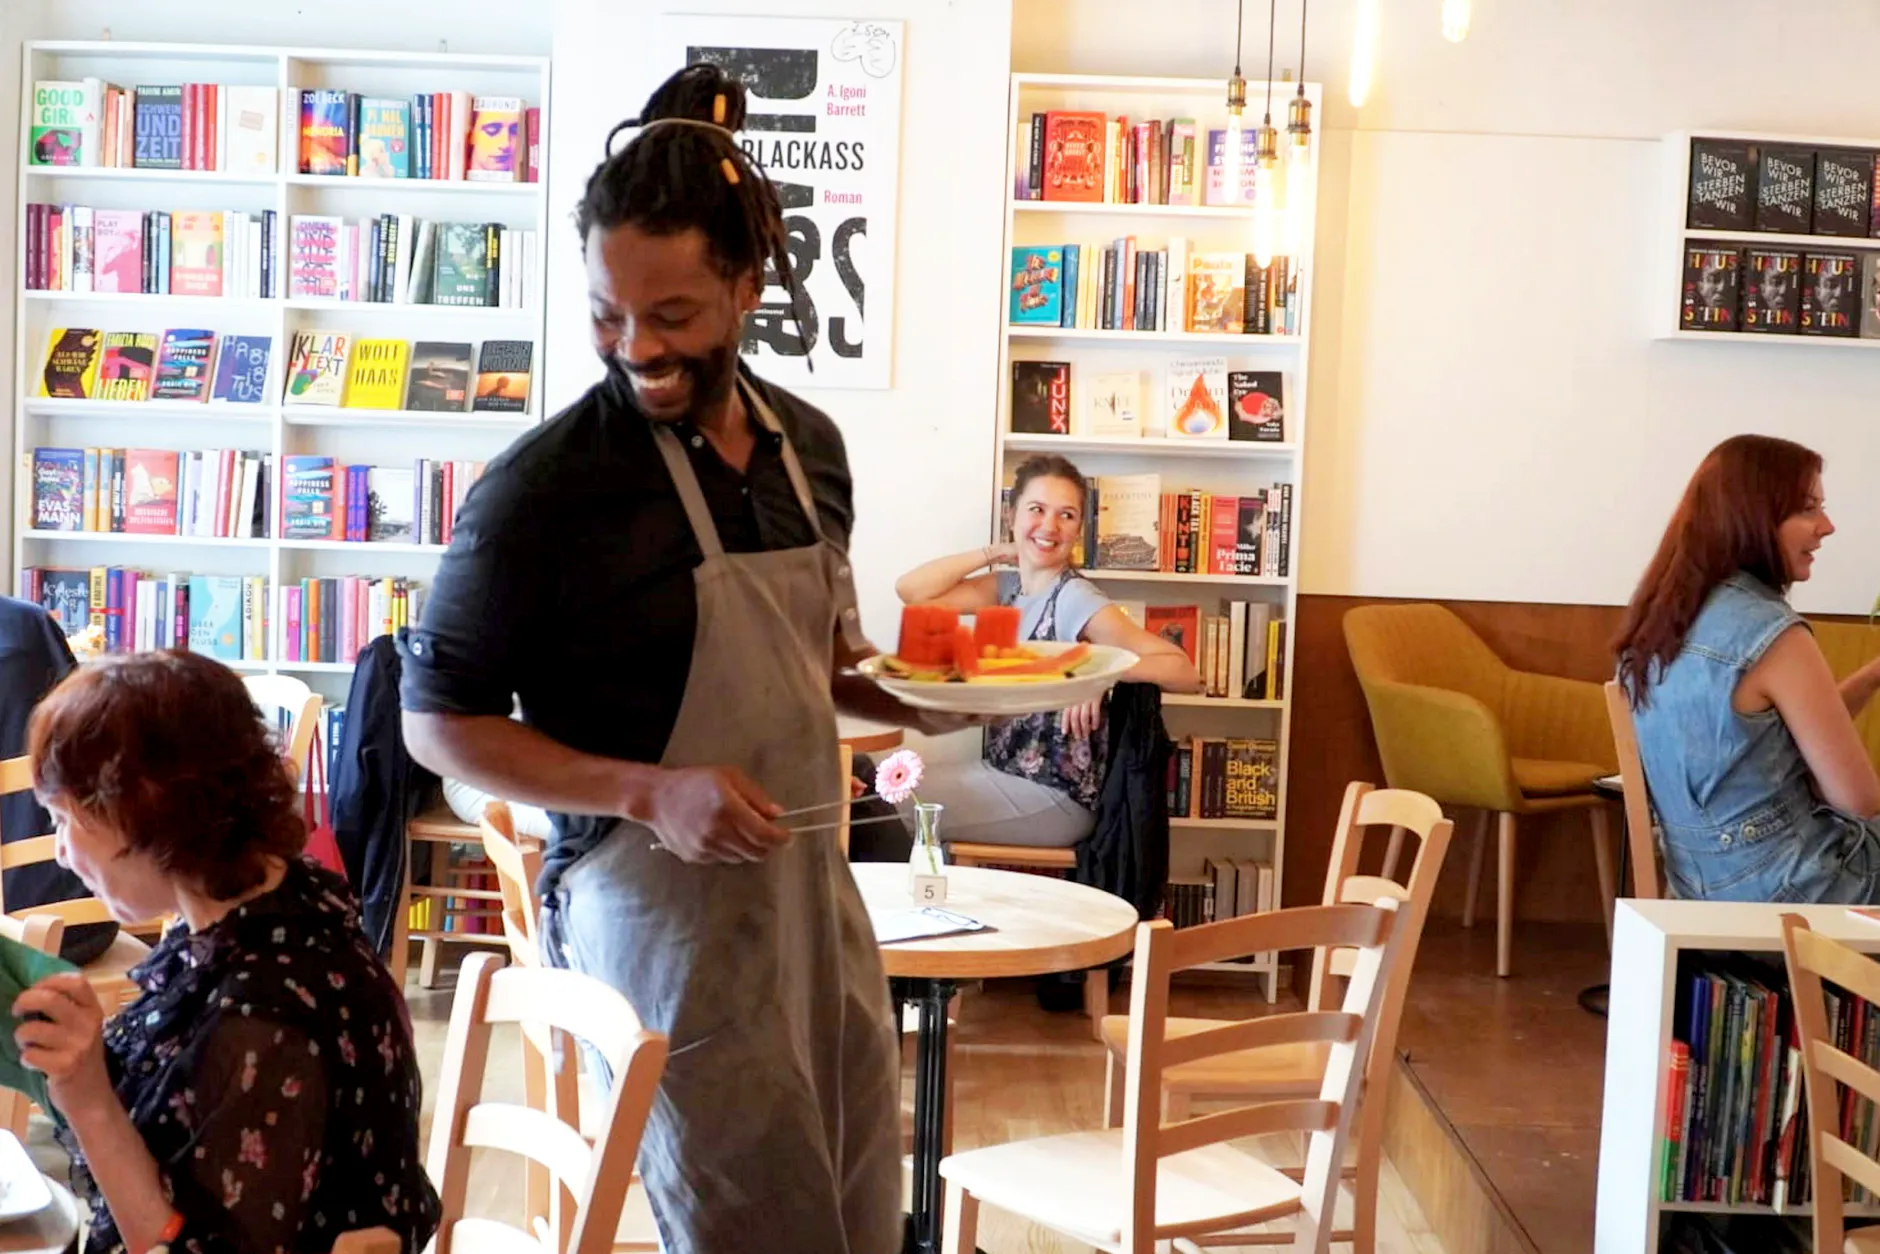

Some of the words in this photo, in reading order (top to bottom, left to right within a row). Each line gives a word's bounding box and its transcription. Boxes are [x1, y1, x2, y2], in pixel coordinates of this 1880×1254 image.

[37, 88, 84, 106] GOOD
[827, 84, 837, 98] A.
[840, 84, 866, 100] Igoni
[827, 103, 866, 117] Barrett
[137, 114, 181, 136] UND
[136, 137, 181, 158] ZEIT
[1701, 152, 1737, 173] BEVOR
[1767, 157, 1802, 177] BEVOR
[1703, 165, 1723, 179] WIR
[1767, 169, 1788, 182] WIR
[1824, 161, 1859, 181] BEVOR
[1824, 173, 1845, 185] WIR
[1697, 173, 1745, 191] STERBEN
[1763, 178, 1810, 195] STERBEN
[1819, 181, 1867, 199] STERBEN
[824, 190, 862, 204] Roman
[1698, 186, 1744, 203] TANZEN
[1764, 190, 1809, 206] TANZEN
[1820, 194, 1866, 210] TANZEN
[1715, 199, 1736, 214] WIR
[1781, 203, 1802, 217] WIR
[1838, 206, 1859, 221] WIR
[456, 285, 475, 293] UNS
[437, 295, 484, 305] TREFFEN
[295, 335, 346, 361] KLAR
[359, 343, 399, 361] WOLF
[309, 354, 343, 376] TEXT
[355, 368, 398, 387] HAAS
[38, 500, 71, 512] EVAS
[38, 512, 80, 524] MANN
[1216, 550, 1256, 562] Prima
[1219, 562, 1252, 572] Facie
[1227, 760, 1271, 776] Black
[1226, 777, 1257, 790] and
[1226, 790, 1276, 805] British
[924, 885, 934, 899] 5
